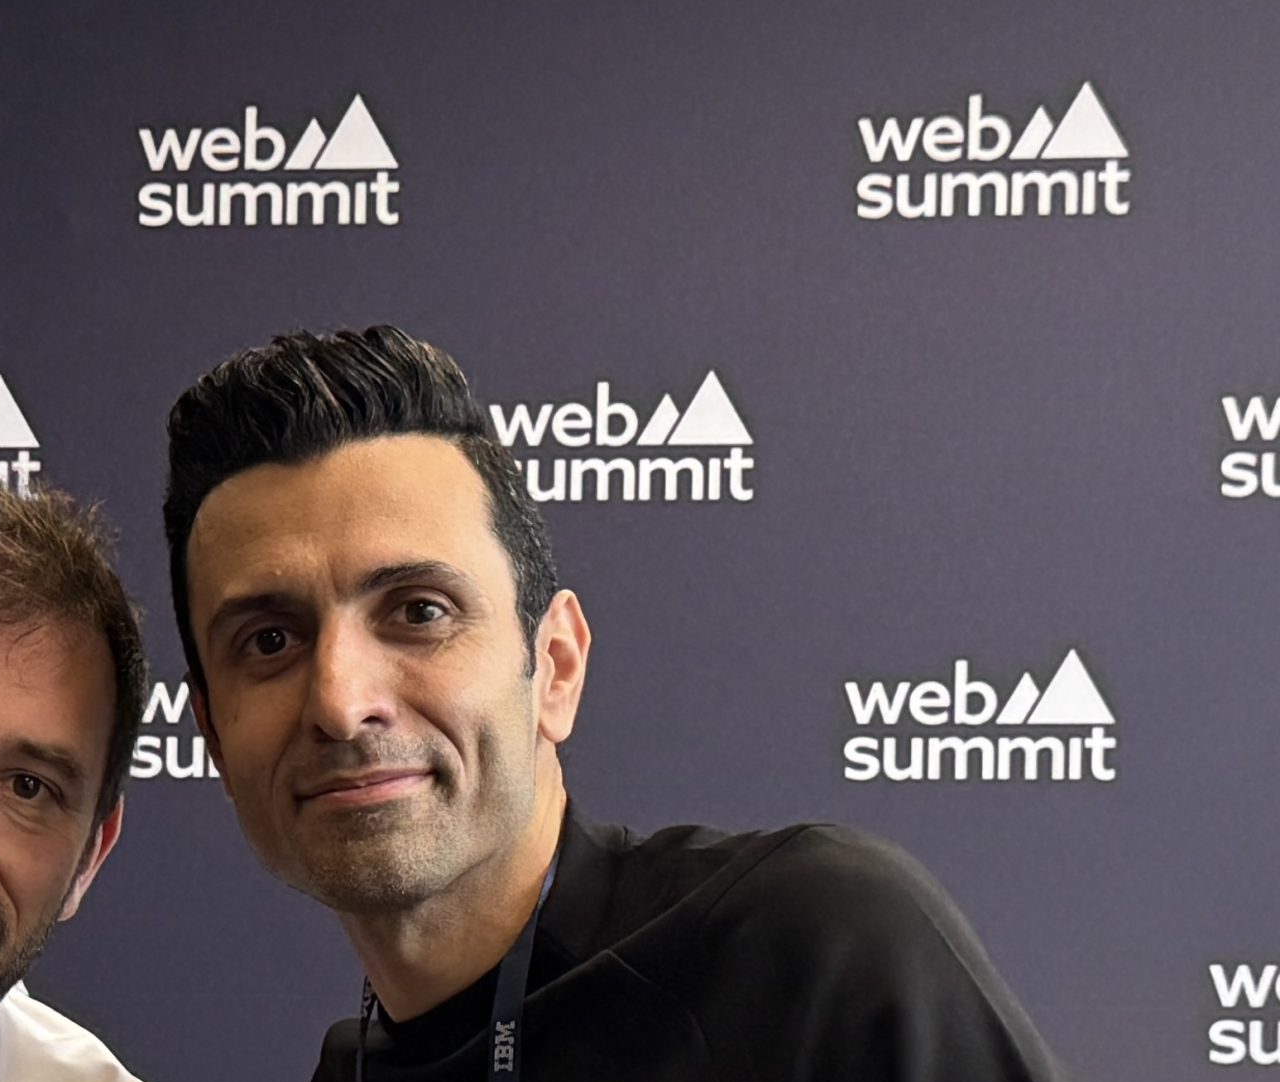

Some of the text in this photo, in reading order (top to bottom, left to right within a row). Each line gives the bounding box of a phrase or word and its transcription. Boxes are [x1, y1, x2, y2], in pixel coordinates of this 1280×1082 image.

[140, 107, 285, 171] web
[859, 95, 1011, 162] web
[139, 172, 399, 226] summit
[857, 160, 1130, 218] summit
[490, 382, 638, 447] web
[514, 448, 754, 501] ummit
[845, 660, 997, 725] web
[844, 727, 1116, 781] summit
[494, 1020, 516, 1072] IBM
